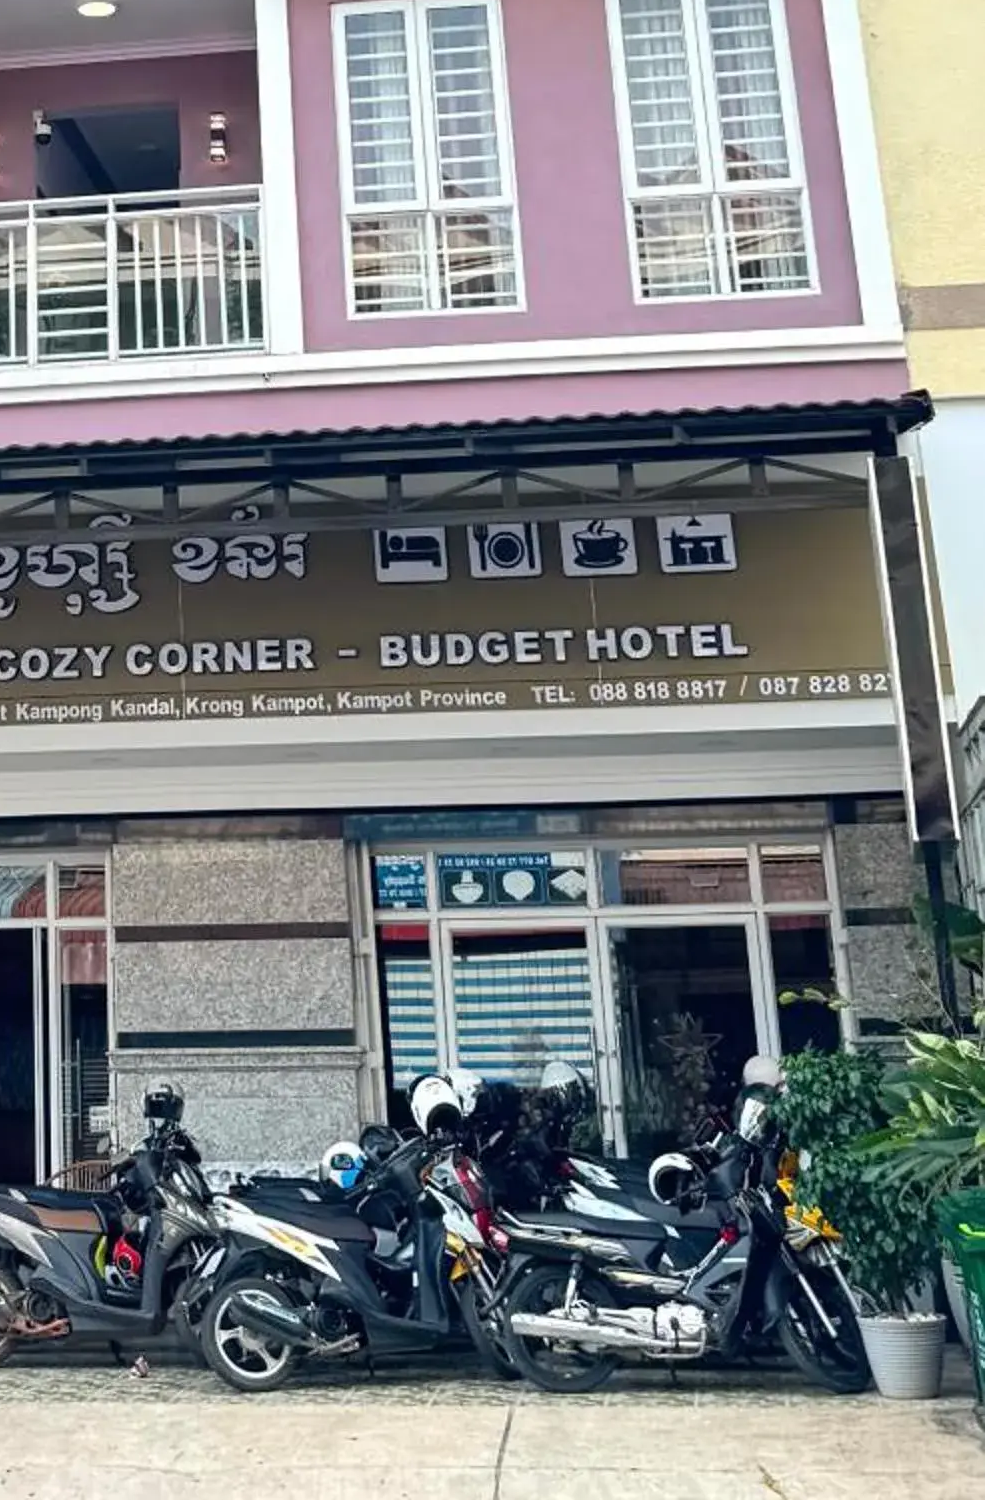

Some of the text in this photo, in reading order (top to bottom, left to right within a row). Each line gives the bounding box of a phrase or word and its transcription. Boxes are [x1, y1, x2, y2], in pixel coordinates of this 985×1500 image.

[124, 637, 317, 676] CORNER
[378, 630, 573, 670] BUDGET
[586, 623, 750, 663] HOTEL
[15, 699, 103, 726] Kampong
[109, 697, 181, 722] Kandal,
[185, 695, 244, 720] Krong
[251, 693, 332, 717] Kampot,
[337, 690, 413, 714] Kampot
[419, 686, 507, 707] Province
[588, 683, 628, 702] 088
[634, 682, 671, 701] 818
[677, 679, 727, 699] 8817
[739, 675, 748, 696] /
[759, 676, 800, 696] 087
[808, 673, 850, 694] 828
[858, 672, 892, 692] 82
